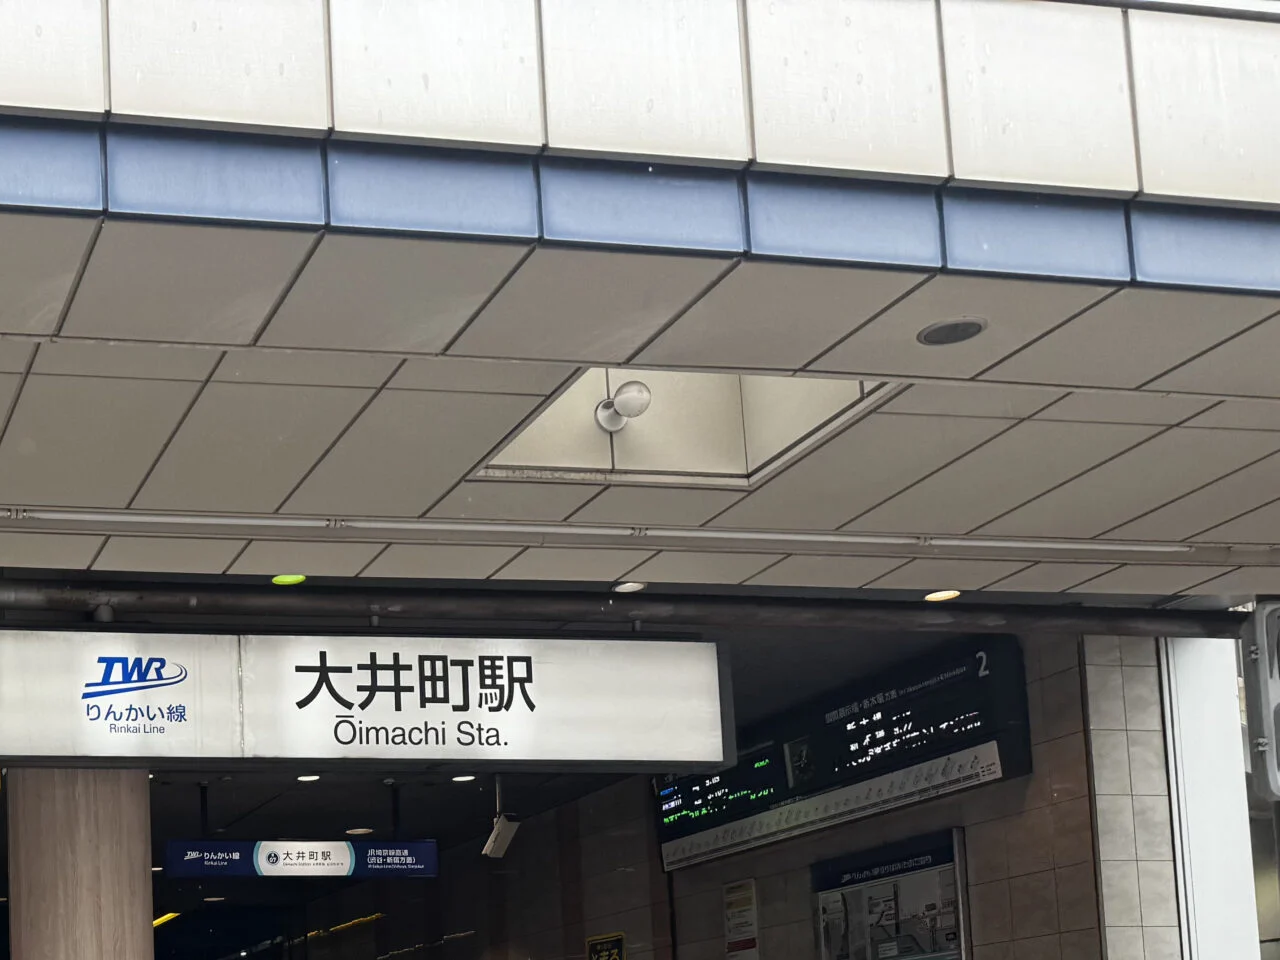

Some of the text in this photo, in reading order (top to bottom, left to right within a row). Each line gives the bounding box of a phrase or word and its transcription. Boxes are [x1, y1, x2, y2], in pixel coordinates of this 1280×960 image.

[97, 656, 166, 684] TWR
[976, 651, 989, 677] 2
[295, 651, 536, 712] 大井町駅
[86, 704, 187, 722] りんかい線
[109, 723, 165, 734] Rinkai Line
[334, 715, 508, 746] Ōimachi Sta.
[204, 851, 240, 860] りんかい線
[283, 851, 331, 861] 大井町駅
